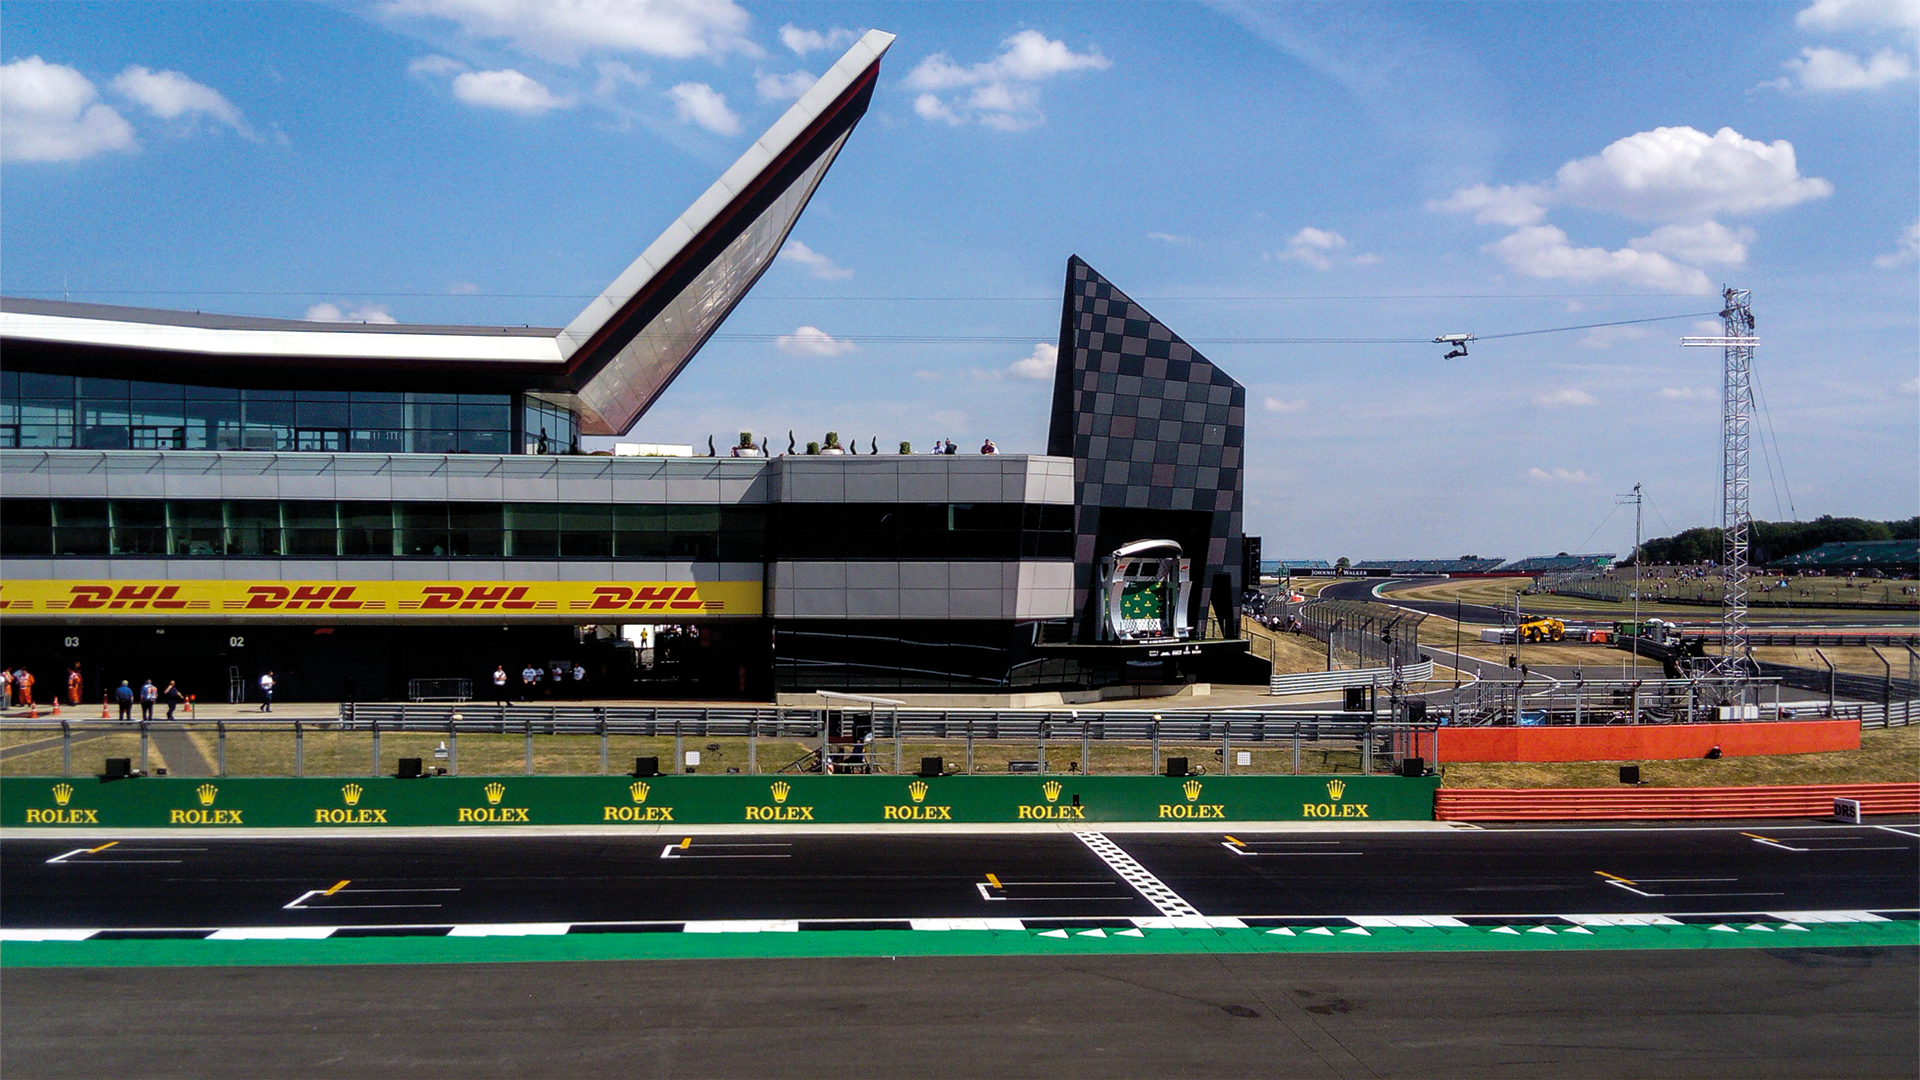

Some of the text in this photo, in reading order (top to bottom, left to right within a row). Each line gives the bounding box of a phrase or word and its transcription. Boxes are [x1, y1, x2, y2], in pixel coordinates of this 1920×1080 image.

[68, 585, 188, 609] DHL
[245, 586, 364, 609] DHL
[420, 586, 536, 609] DHL
[590, 587, 704, 609] DHL
[64, 636, 79, 647] 03
[229, 636, 244, 647] 02
[26, 809, 98, 823] ROLEX
[170, 809, 243, 824] ROLEX
[315, 809, 387, 823] ROLEX
[458, 807, 530, 822] ROLEX
[603, 806, 674, 821] ROLEX
[745, 806, 814, 820] ROLEX
[884, 805, 952, 820] ROLEX
[1017, 805, 1085, 819] ROLEX
[1158, 804, 1225, 818] ROLEX
[1302, 803, 1369, 817] ROLEX
[1834, 803, 1856, 818] DRS
